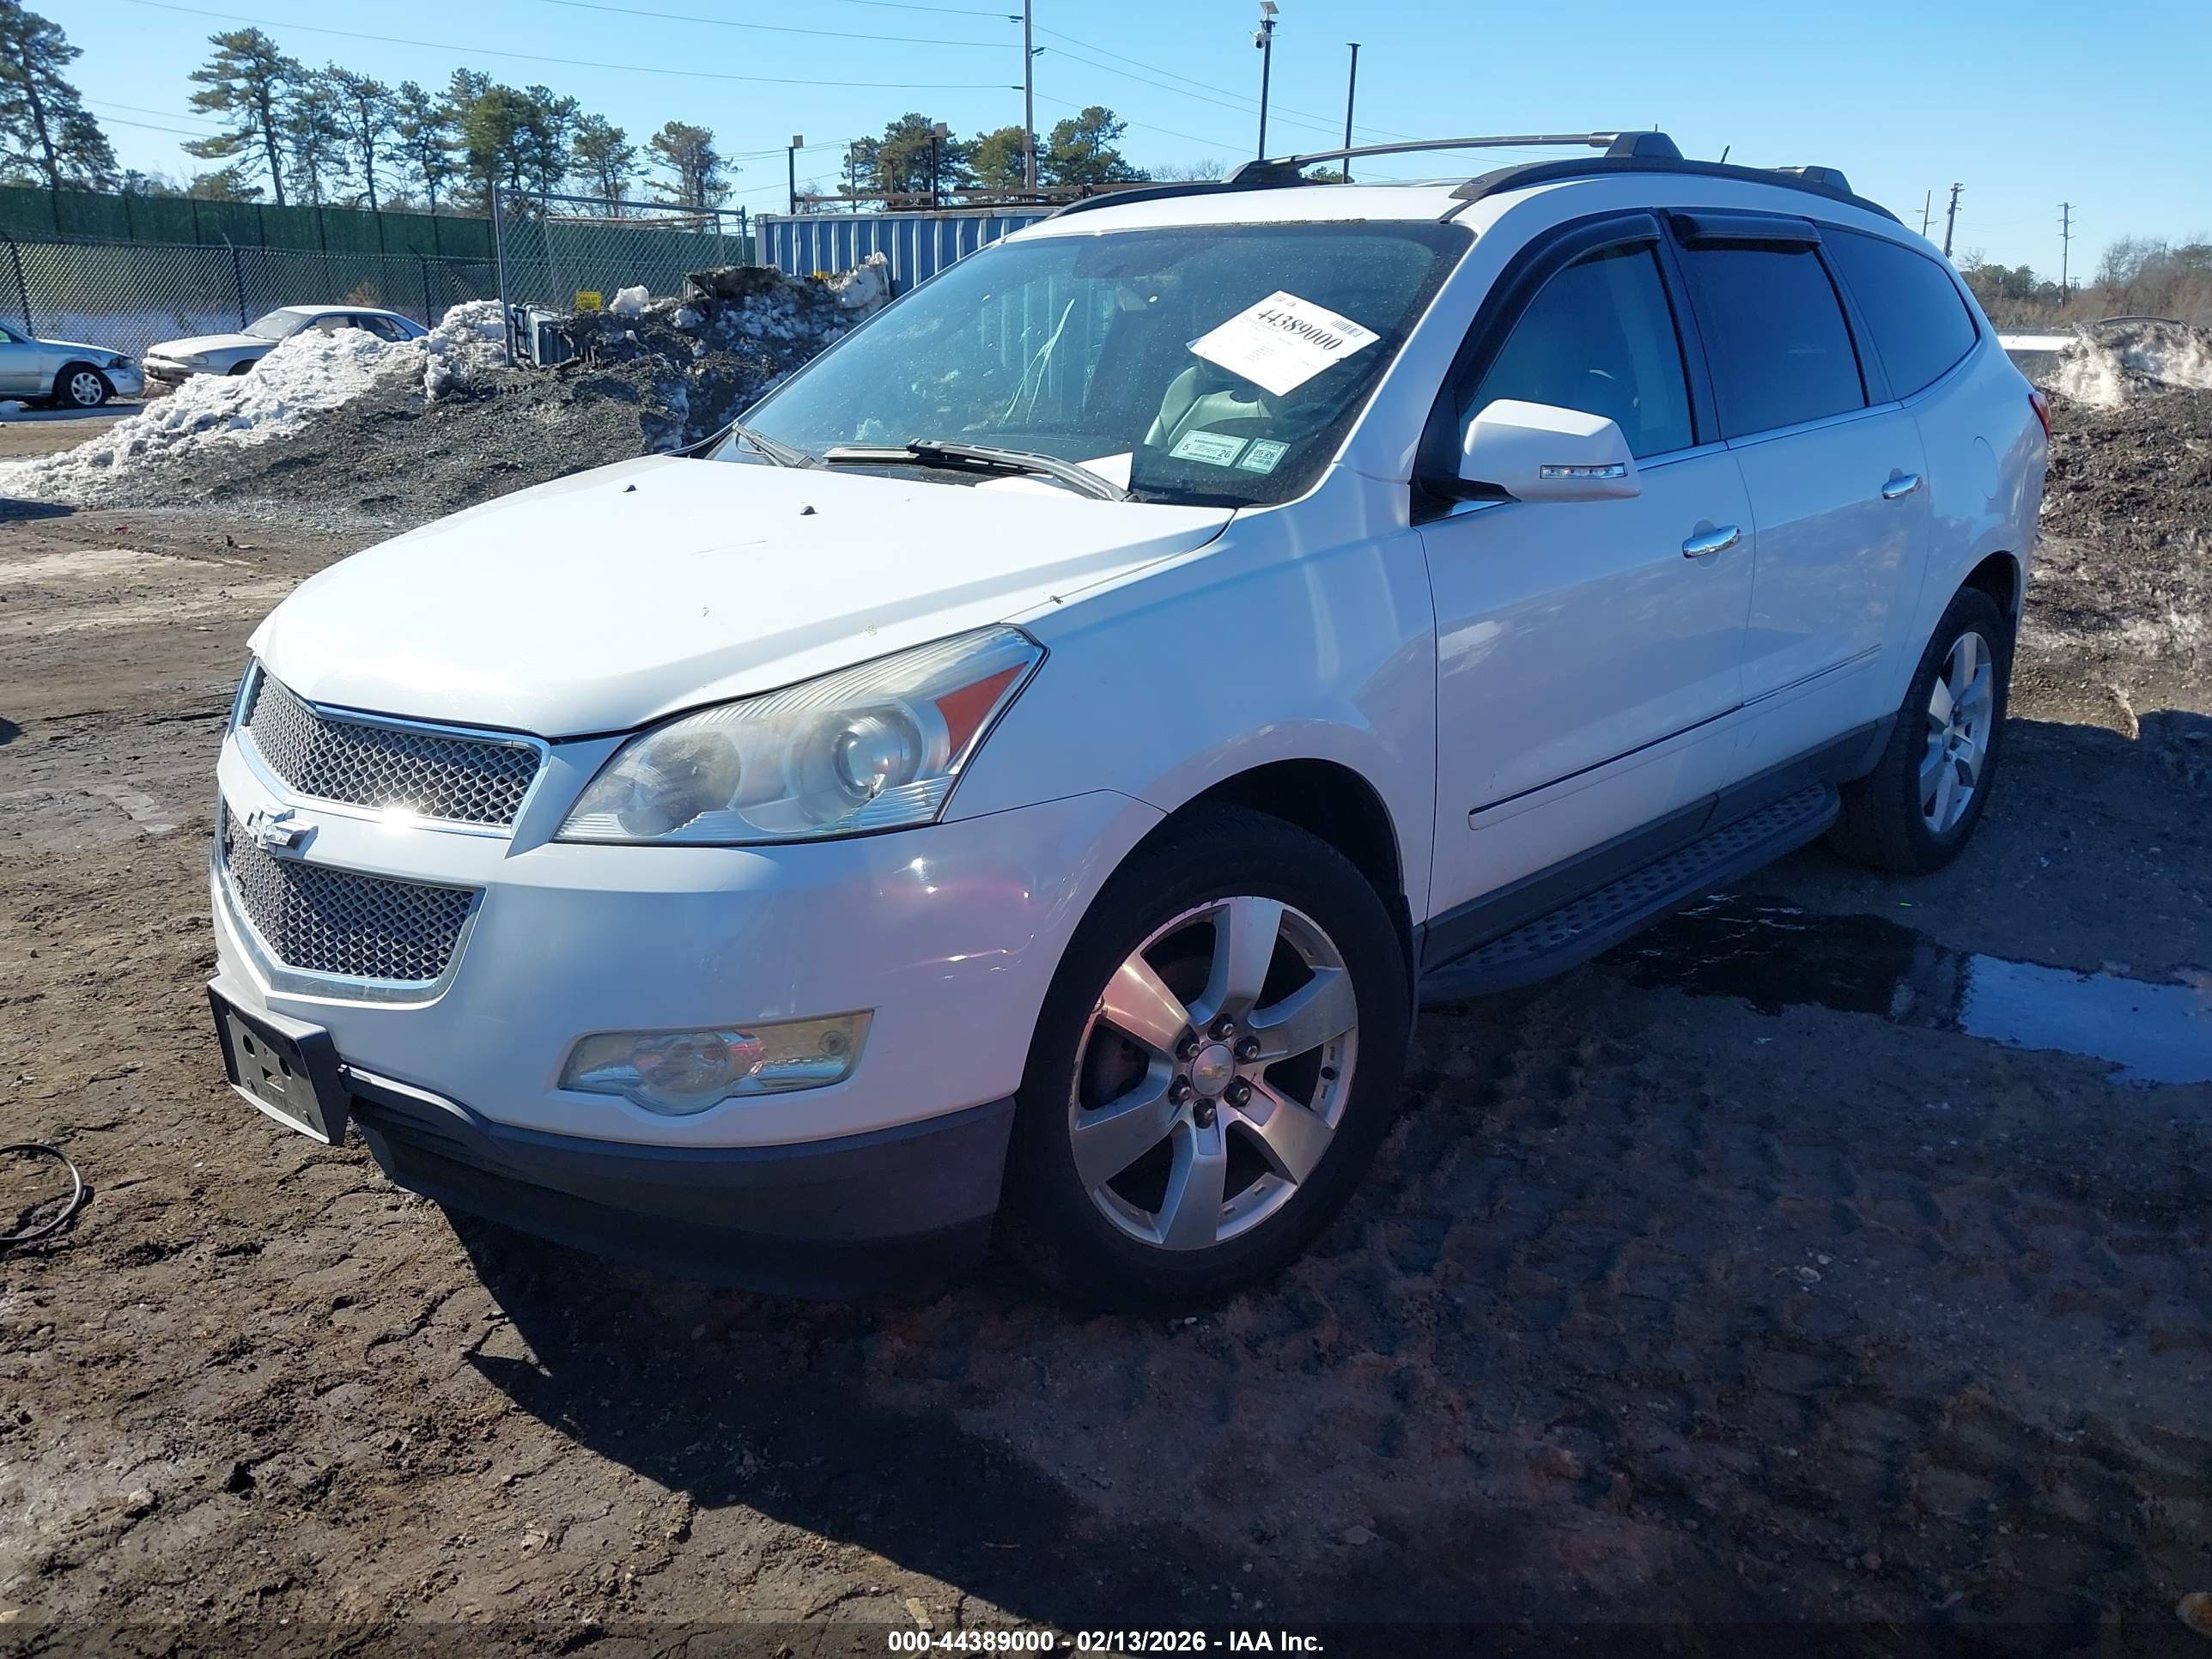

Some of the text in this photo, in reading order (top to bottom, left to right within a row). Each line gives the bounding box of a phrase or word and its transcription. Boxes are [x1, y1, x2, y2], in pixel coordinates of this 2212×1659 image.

[1257, 308, 1344, 350] 44389000
[1182, 443, 1191, 452] 5
[1218, 449, 1233, 459] 26
